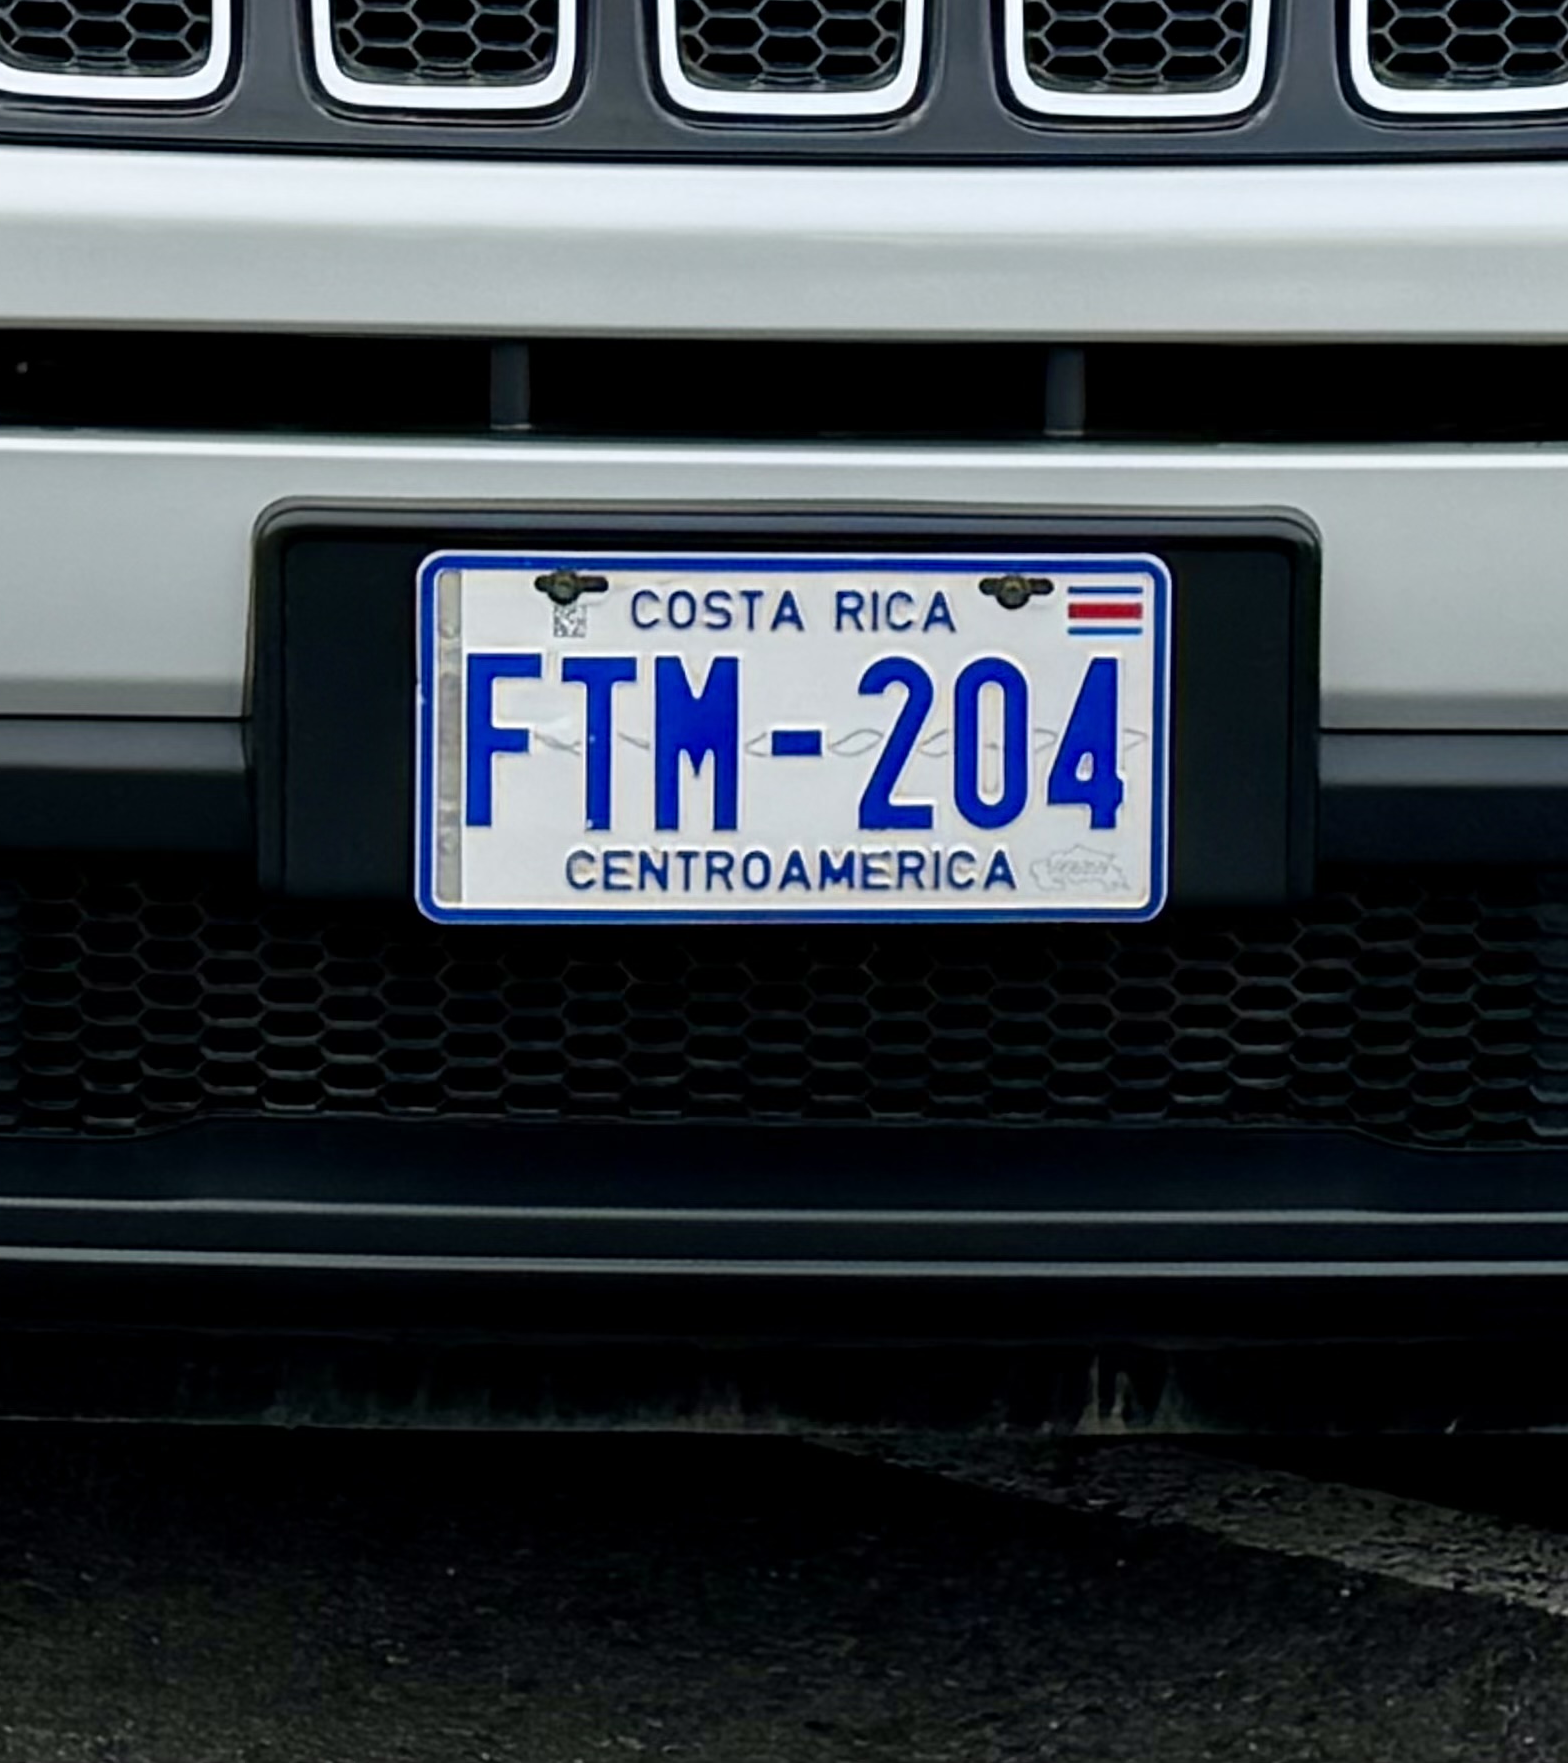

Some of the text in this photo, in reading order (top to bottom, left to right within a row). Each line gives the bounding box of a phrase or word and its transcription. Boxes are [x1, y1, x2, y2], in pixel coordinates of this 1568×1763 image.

[631, 589, 955, 633] COSTA RICA
[465, 652, 1125, 832] FTM-204
[566, 850, 1017, 892] CENTROAMERICA
